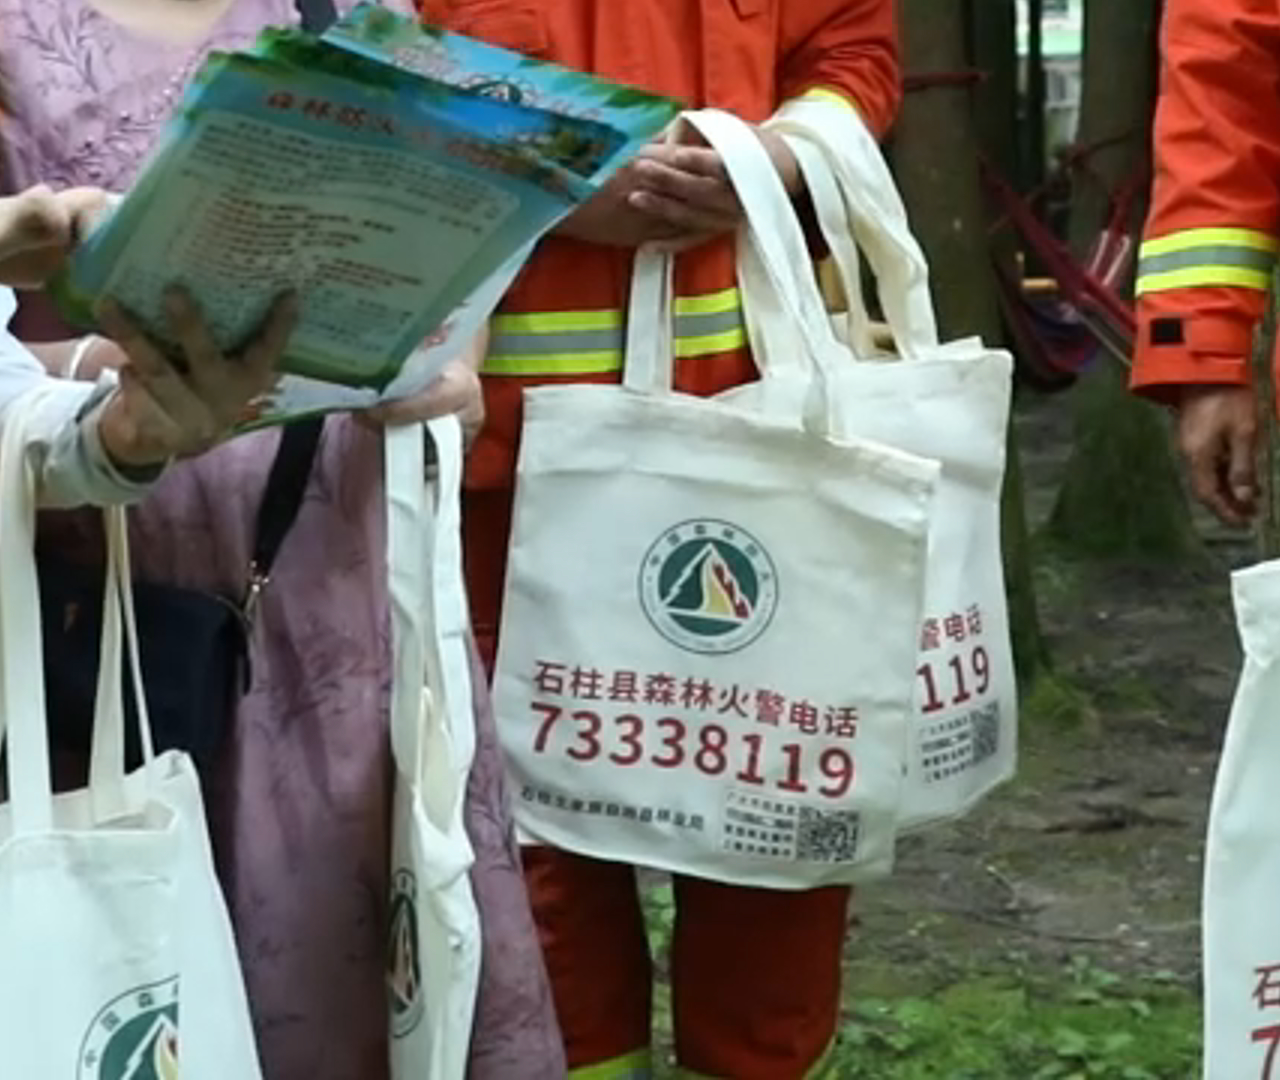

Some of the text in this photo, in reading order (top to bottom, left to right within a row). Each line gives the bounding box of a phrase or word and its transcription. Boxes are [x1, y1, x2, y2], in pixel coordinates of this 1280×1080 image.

[532, 659, 859, 739] 石柱县森林火警电话
[916, 645, 990, 714] 119
[530, 701, 855, 799] 73338119
